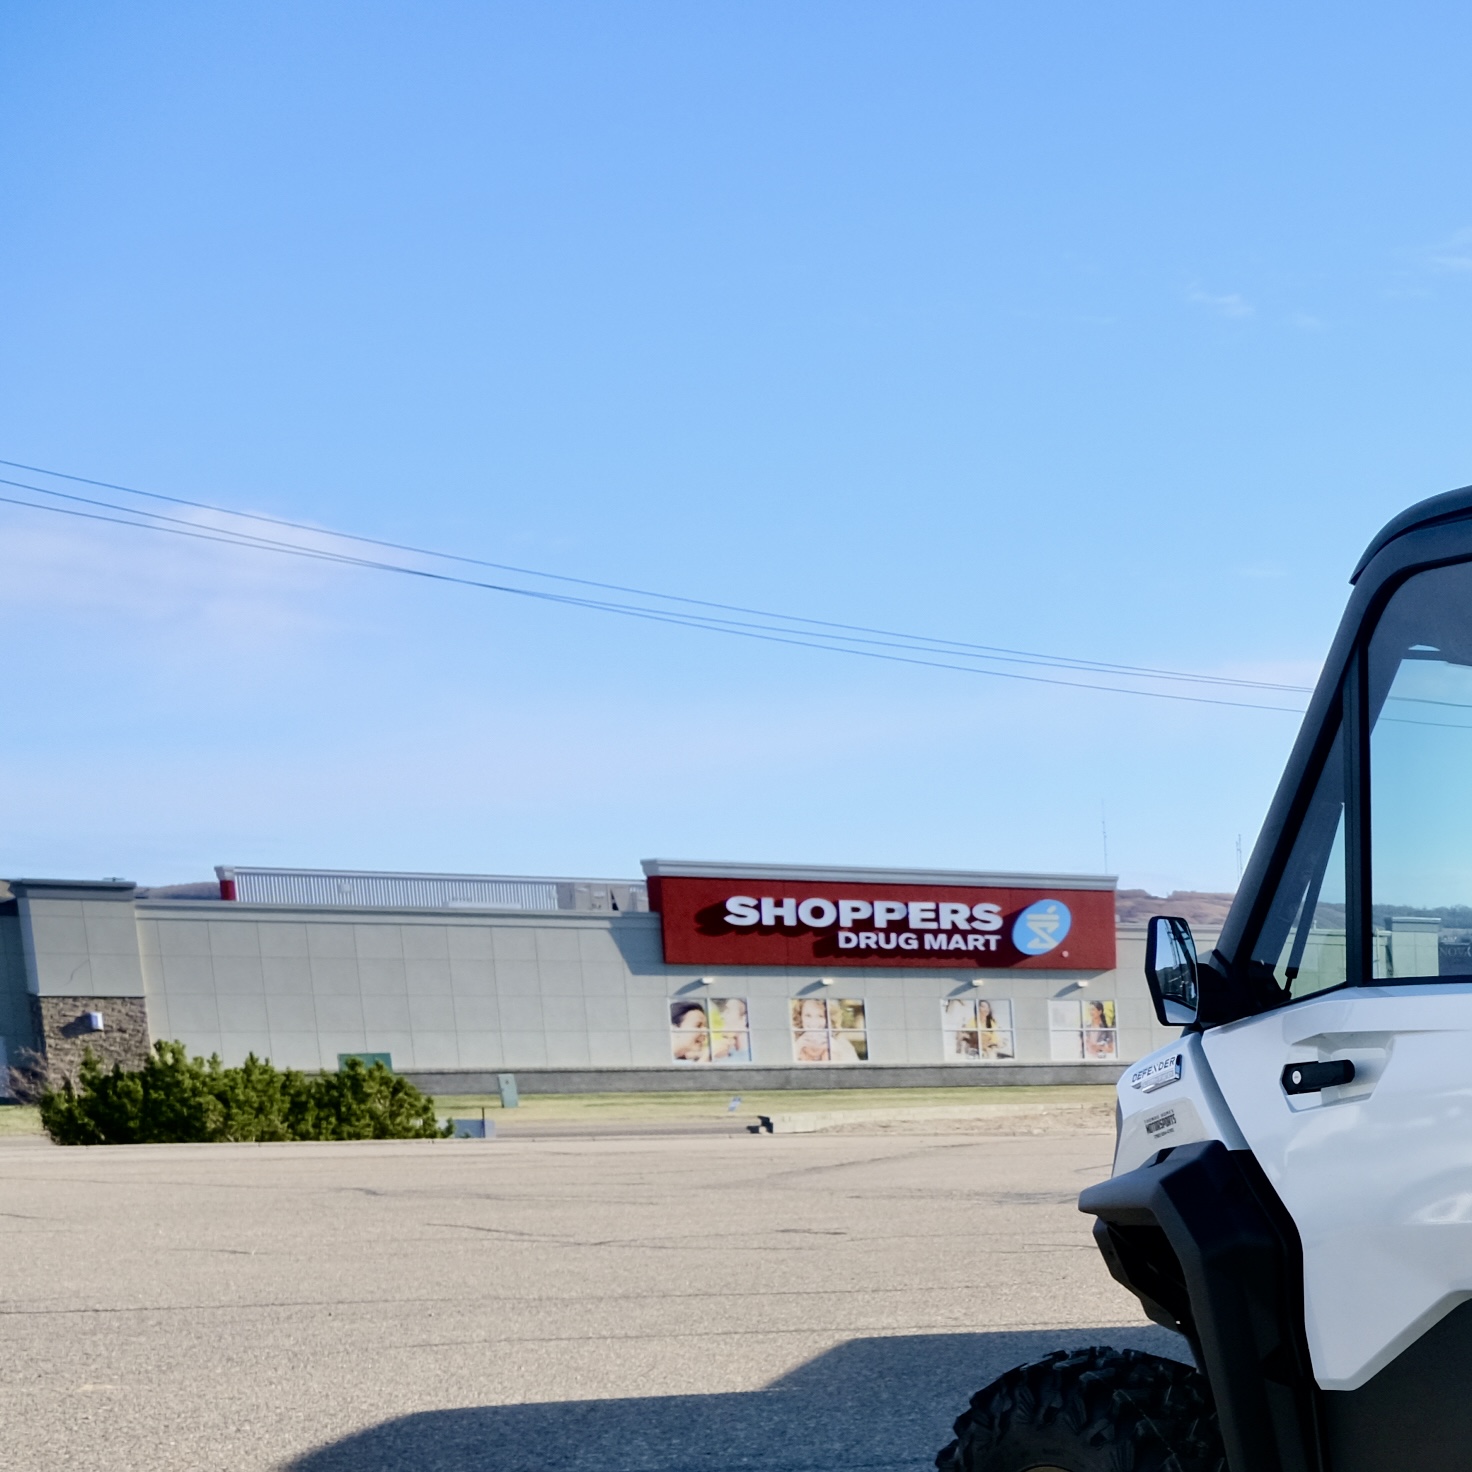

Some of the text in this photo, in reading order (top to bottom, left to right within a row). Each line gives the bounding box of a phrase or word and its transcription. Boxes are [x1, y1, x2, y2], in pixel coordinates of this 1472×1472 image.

[722, 894, 1005, 932] SHOPPERS
[837, 931, 1003, 952] DRUG MART
[1132, 1056, 1176, 1082] DEFENDER
